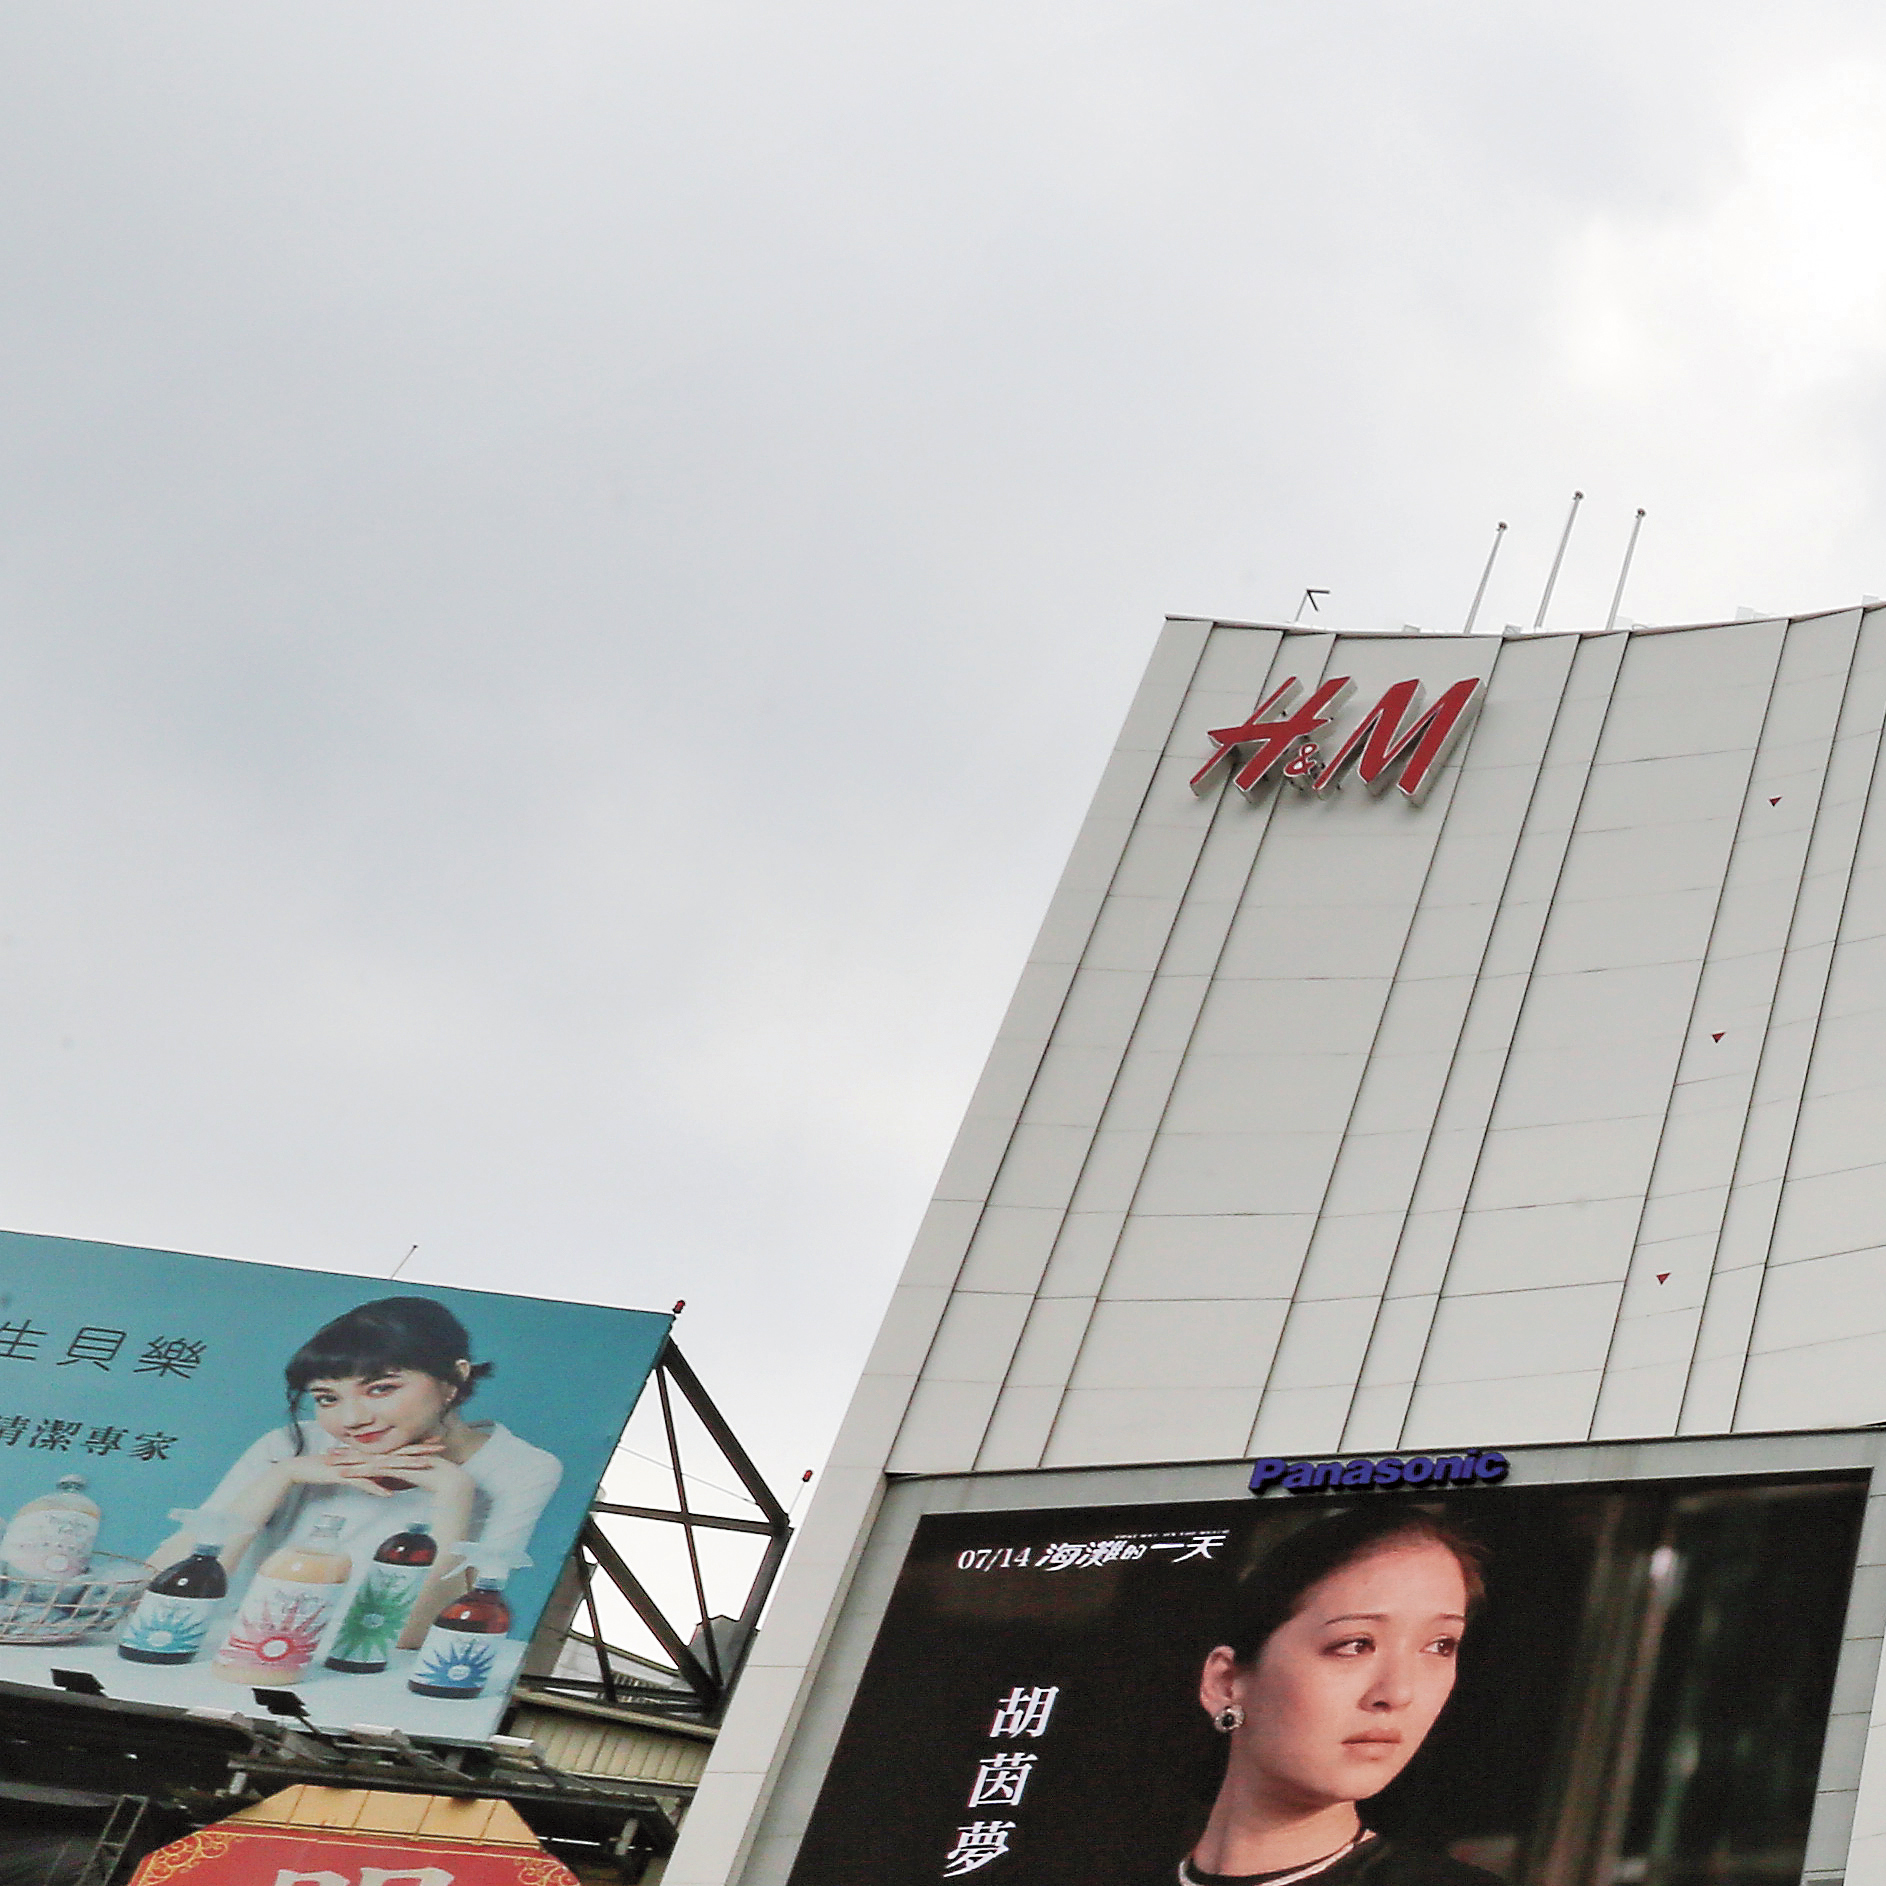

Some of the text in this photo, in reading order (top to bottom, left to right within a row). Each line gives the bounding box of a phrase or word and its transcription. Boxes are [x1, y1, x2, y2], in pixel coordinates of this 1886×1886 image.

[1189, 676, 1488, 805] H&M
[0, 1317, 208, 1381] 生貝樂
[1248, 1449, 1509, 1496] Panasonic
[958, 1535, 1227, 1573] 07/14 海灘的一天
[943, 1685, 1060, 1878] 胡茵夢
